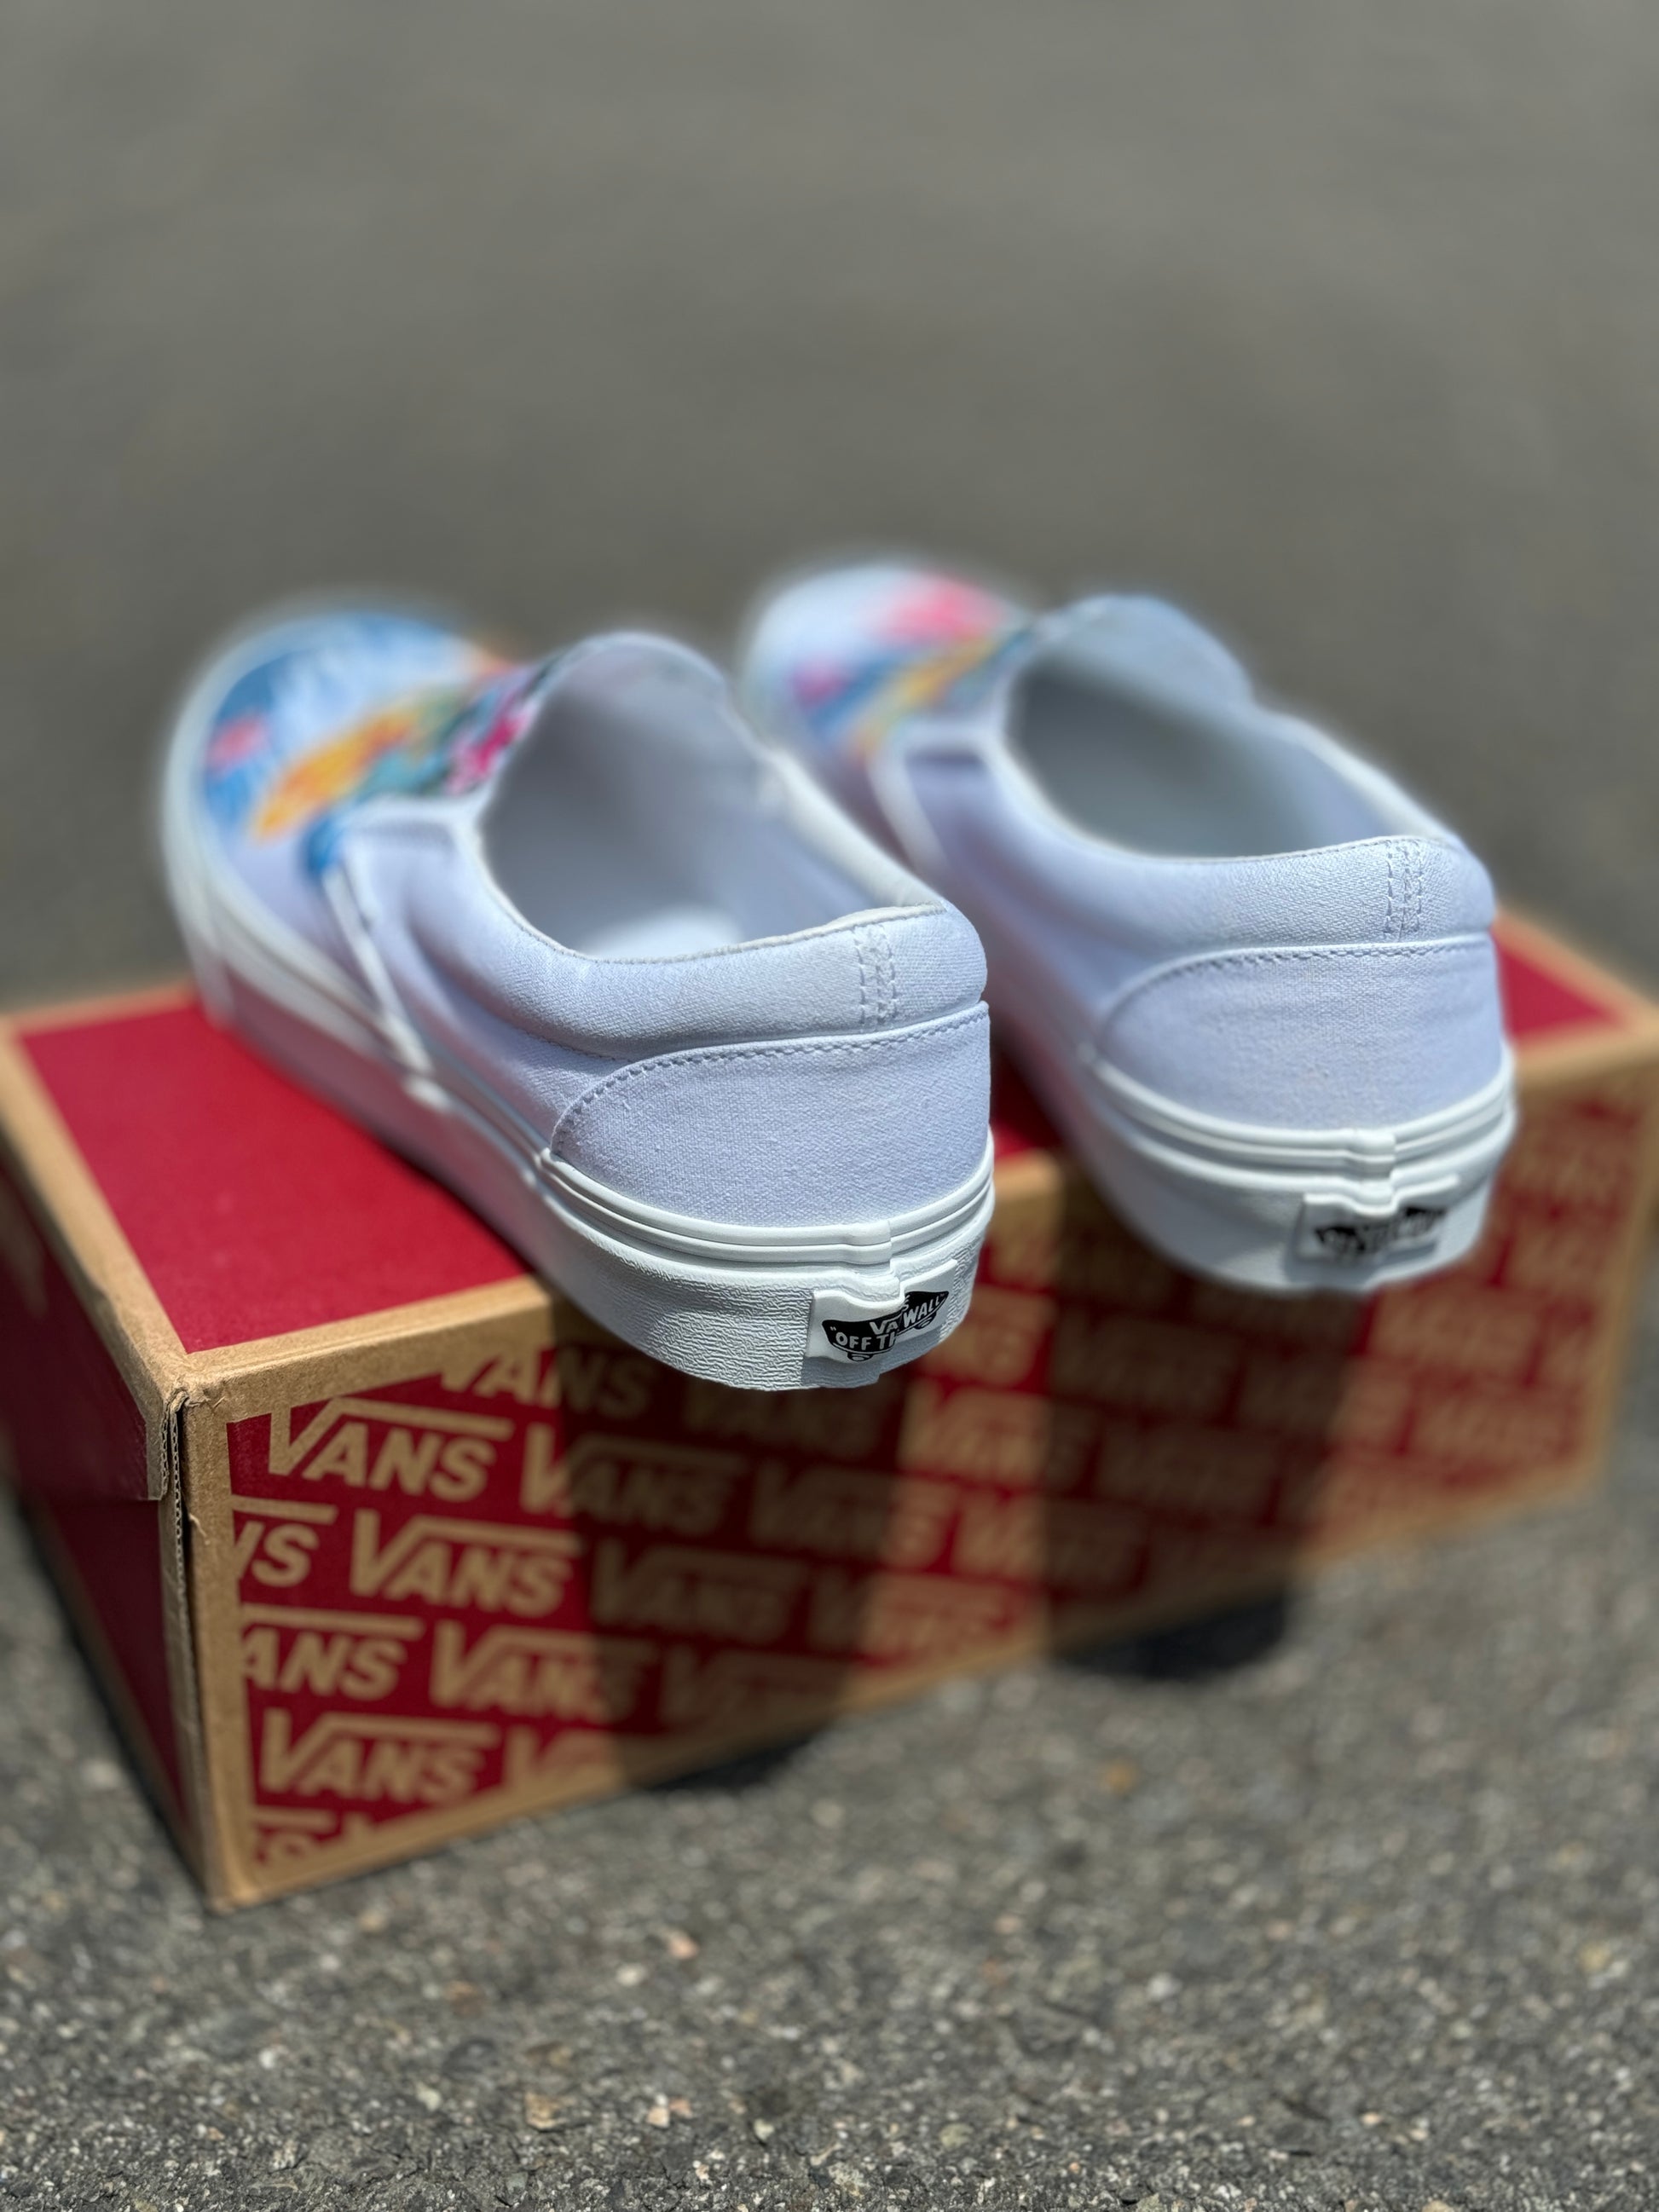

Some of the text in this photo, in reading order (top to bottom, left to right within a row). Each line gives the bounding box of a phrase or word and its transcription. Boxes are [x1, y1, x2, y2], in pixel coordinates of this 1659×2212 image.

[267, 1395, 515, 1502] VANS
[349, 1508, 587, 1618] VANS
[241, 1603, 424, 1701] ANS
[259, 1707, 500, 1804] VANS
